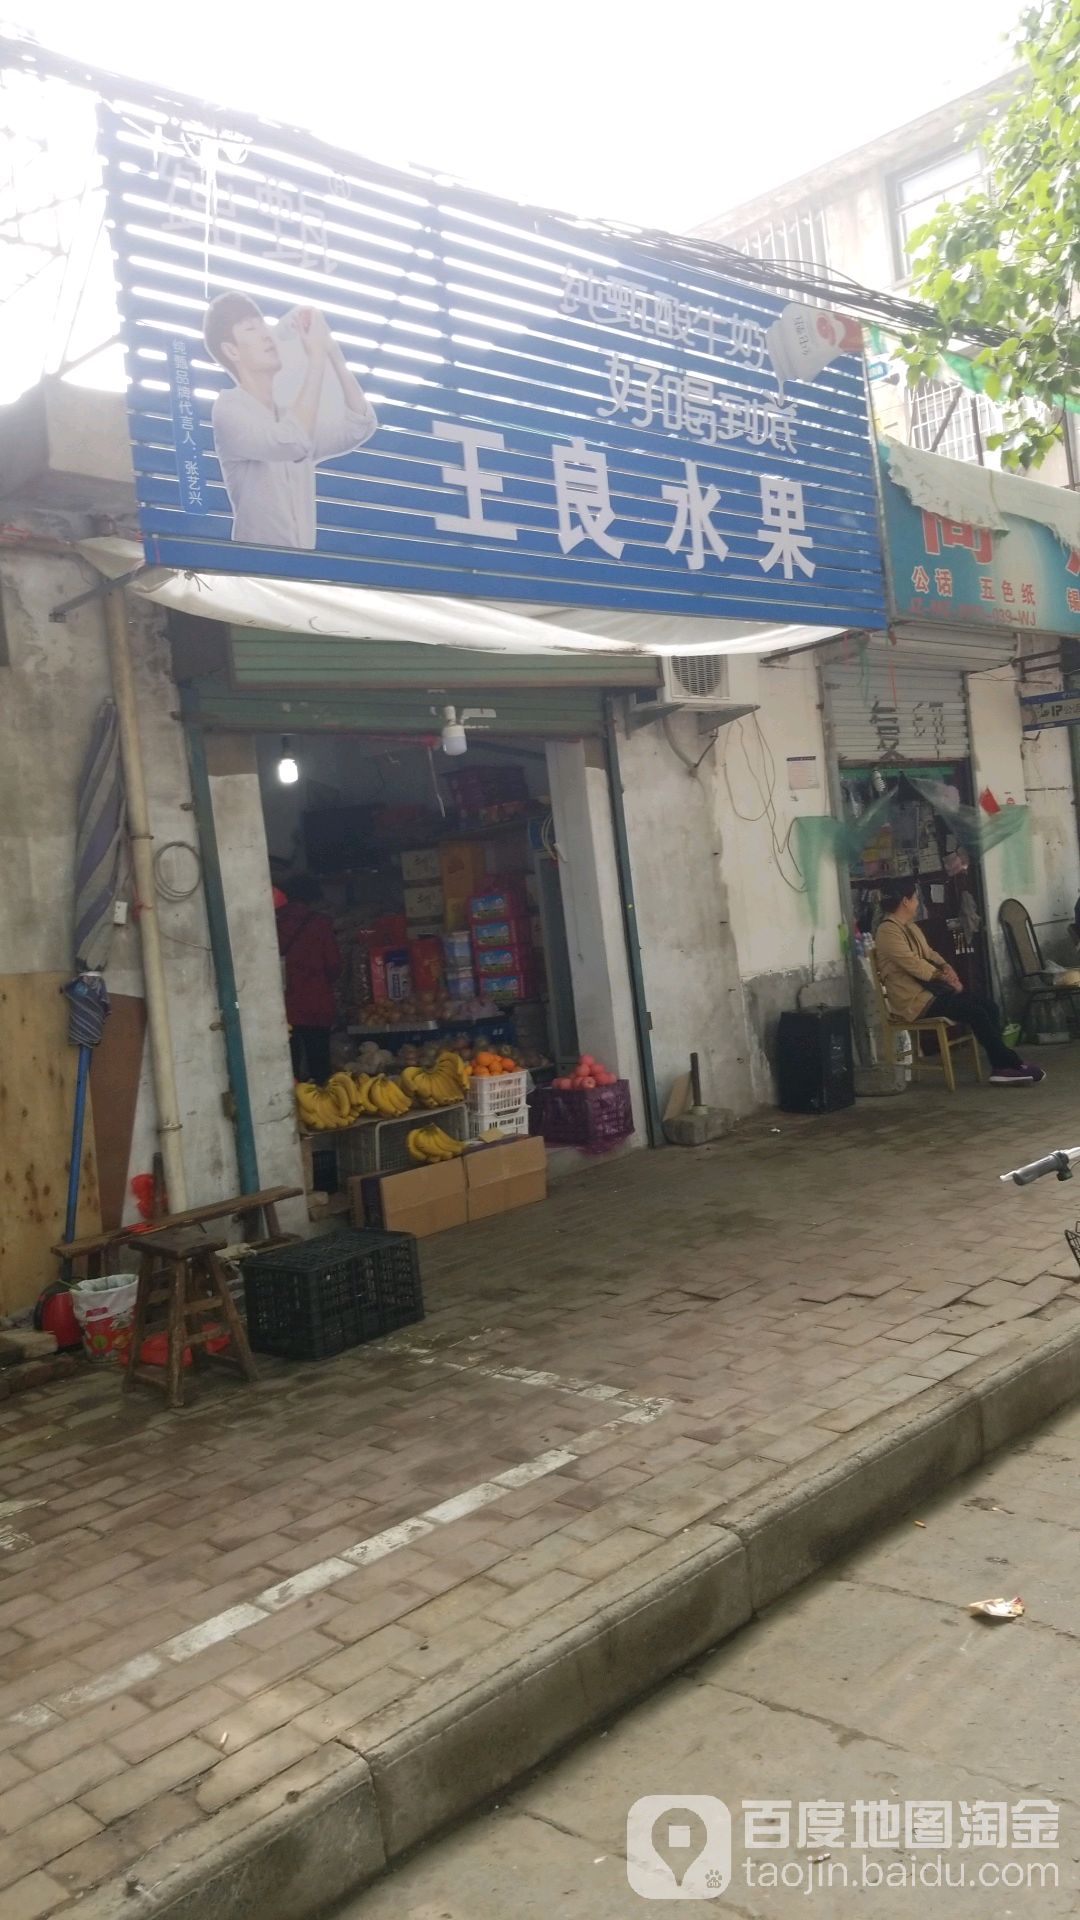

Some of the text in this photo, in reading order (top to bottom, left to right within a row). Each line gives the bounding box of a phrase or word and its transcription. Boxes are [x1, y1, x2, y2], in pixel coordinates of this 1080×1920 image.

[557, 262, 767, 371] 纯甄酸牛奶
[597, 352, 798, 454] 好喝到底
[432, 420, 816, 579] 王良水果
[911, 565, 953, 597] 公话
[979, 577, 1037, 606] 五色纸
